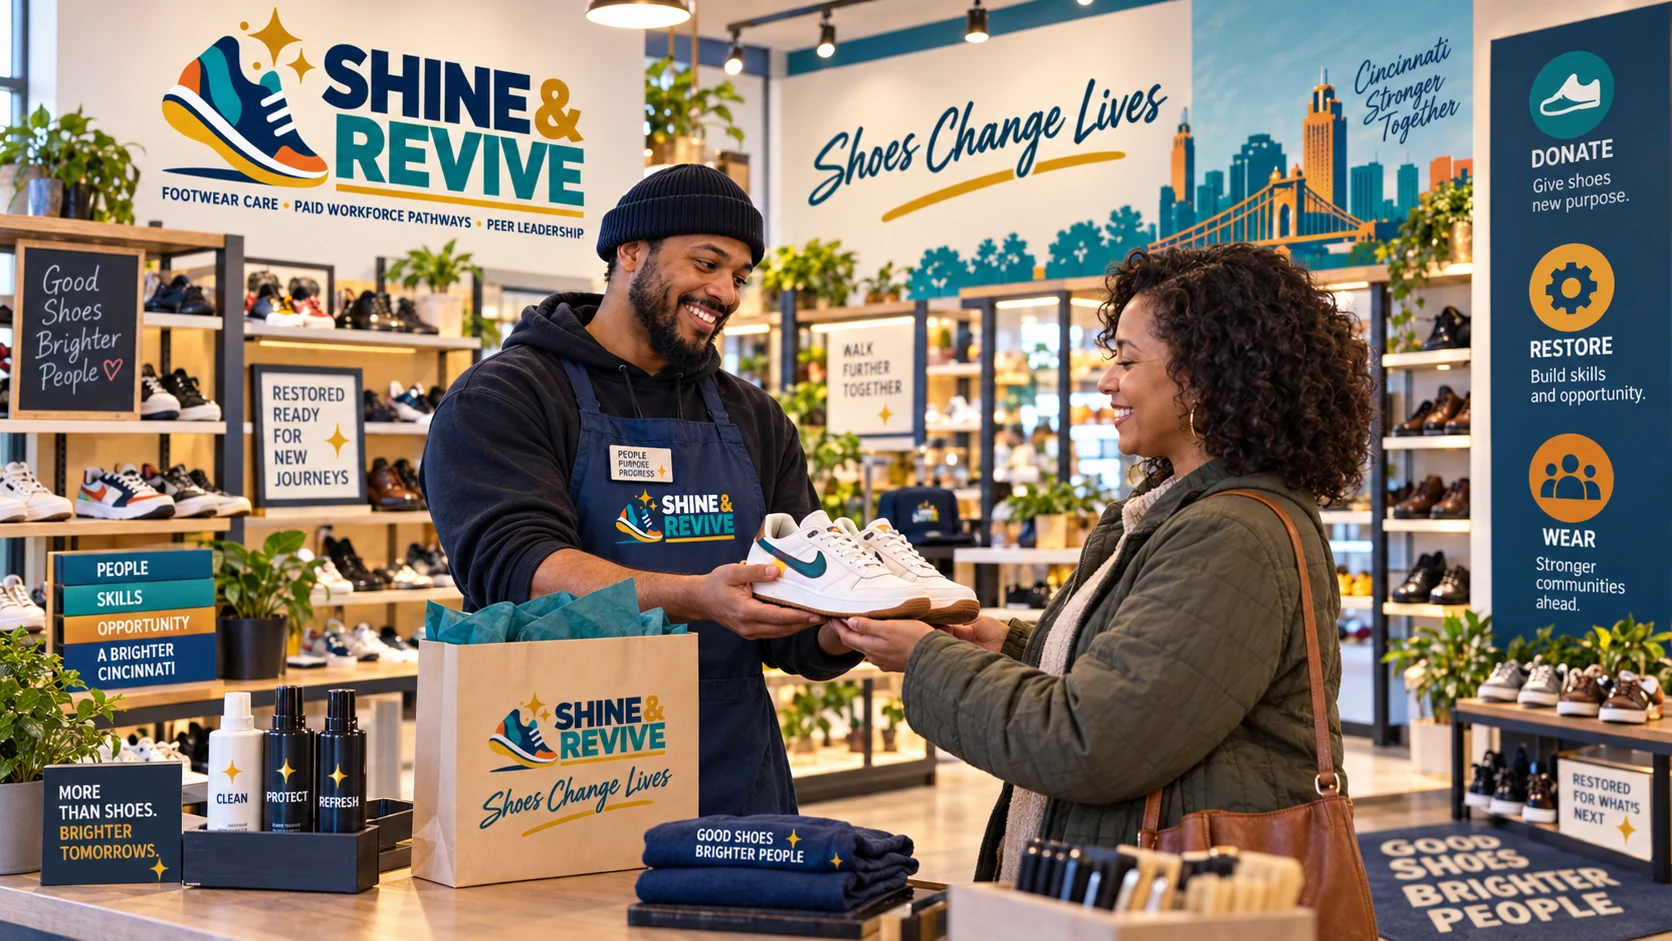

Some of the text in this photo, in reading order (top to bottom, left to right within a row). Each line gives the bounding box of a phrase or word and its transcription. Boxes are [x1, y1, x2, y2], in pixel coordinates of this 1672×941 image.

[1354, 36, 1452, 95] Cincinnati
[322, 43, 531, 136] SHINE
[1363, 74, 1447, 126] Stronger
[1378, 95, 1461, 145] Together
[808, 78, 1168, 206] Shoes Change Lives
[336, 114, 584, 207] REVIVE
[1531, 138, 1614, 168] DONATE
[1533, 172, 1611, 194] Give shoes
[1532, 190, 1630, 213] new purpose.
[162, 186, 585, 240] FOOTWEAR CARE PAID WORKFORCE PATHWAYS PEER LEADERSHIP
[43, 264, 100, 295] Good
[42, 297, 102, 326] Shoes
[35, 326, 122, 364] Brighter
[843, 342, 874, 357] WALK
[1530, 336, 1613, 358] RESTORE
[38, 357, 99, 395] People
[843, 360, 890, 377] FURTHER
[1530, 366, 1606, 384] Build skills
[273, 385, 345, 402] RESTORED
[843, 379, 902, 398] TOGETHER
[1530, 385, 1646, 406] and opportunity.
[273, 407, 320, 422] READY
[274, 428, 302, 444] FOR
[274, 449, 307, 465] NEW
[618, 450, 647, 459] PEOPLE
[274, 470, 349, 487] JOURNEYS
[661, 494, 719, 515] SHINE
[664, 513, 735, 537] REVIVE
[1542, 528, 1596, 548] WEAR
[97, 560, 149, 578] PEOPLE
[1536, 556, 1597, 577] Stronger
[1536, 578, 1626, 594] communities
[97, 590, 143, 607] SKILLS
[1536, 595, 1580, 612] ahead.
[97, 616, 190, 635] OPPORTUNITY
[97, 642, 174, 662] A BRIGHTER
[97, 661, 175, 681] CINCINNATI
[554, 696, 642, 730] SHINE
[560, 722, 666, 760] REVIVE
[59, 784, 101, 800] MORE
[1572, 772, 1631, 795] RESTORED
[216, 792, 248, 804] CLEAN
[266, 790, 309, 803] PROTECT
[319, 796, 359, 808] REFRESH
[479, 766, 673, 829] Shoes Change Lives
[1573, 790, 1641, 815] FOR WHAT'S
[59, 802, 157, 820] THAN SHOES.
[1574, 807, 1605, 825] NEXT
[60, 823, 132, 840] BRIGHTER
[697, 828, 774, 845] GOOD SHOES
[60, 843, 160, 861] TOMORROWS.
[695, 844, 804, 864] BRIGHTER PEOPLE
[1380, 834, 1502, 857] GOOD
[1389, 849, 1530, 881] SHOES
[1401, 867, 1622, 908] BRIGHTER
[1426, 891, 1625, 934] PEOPLE
